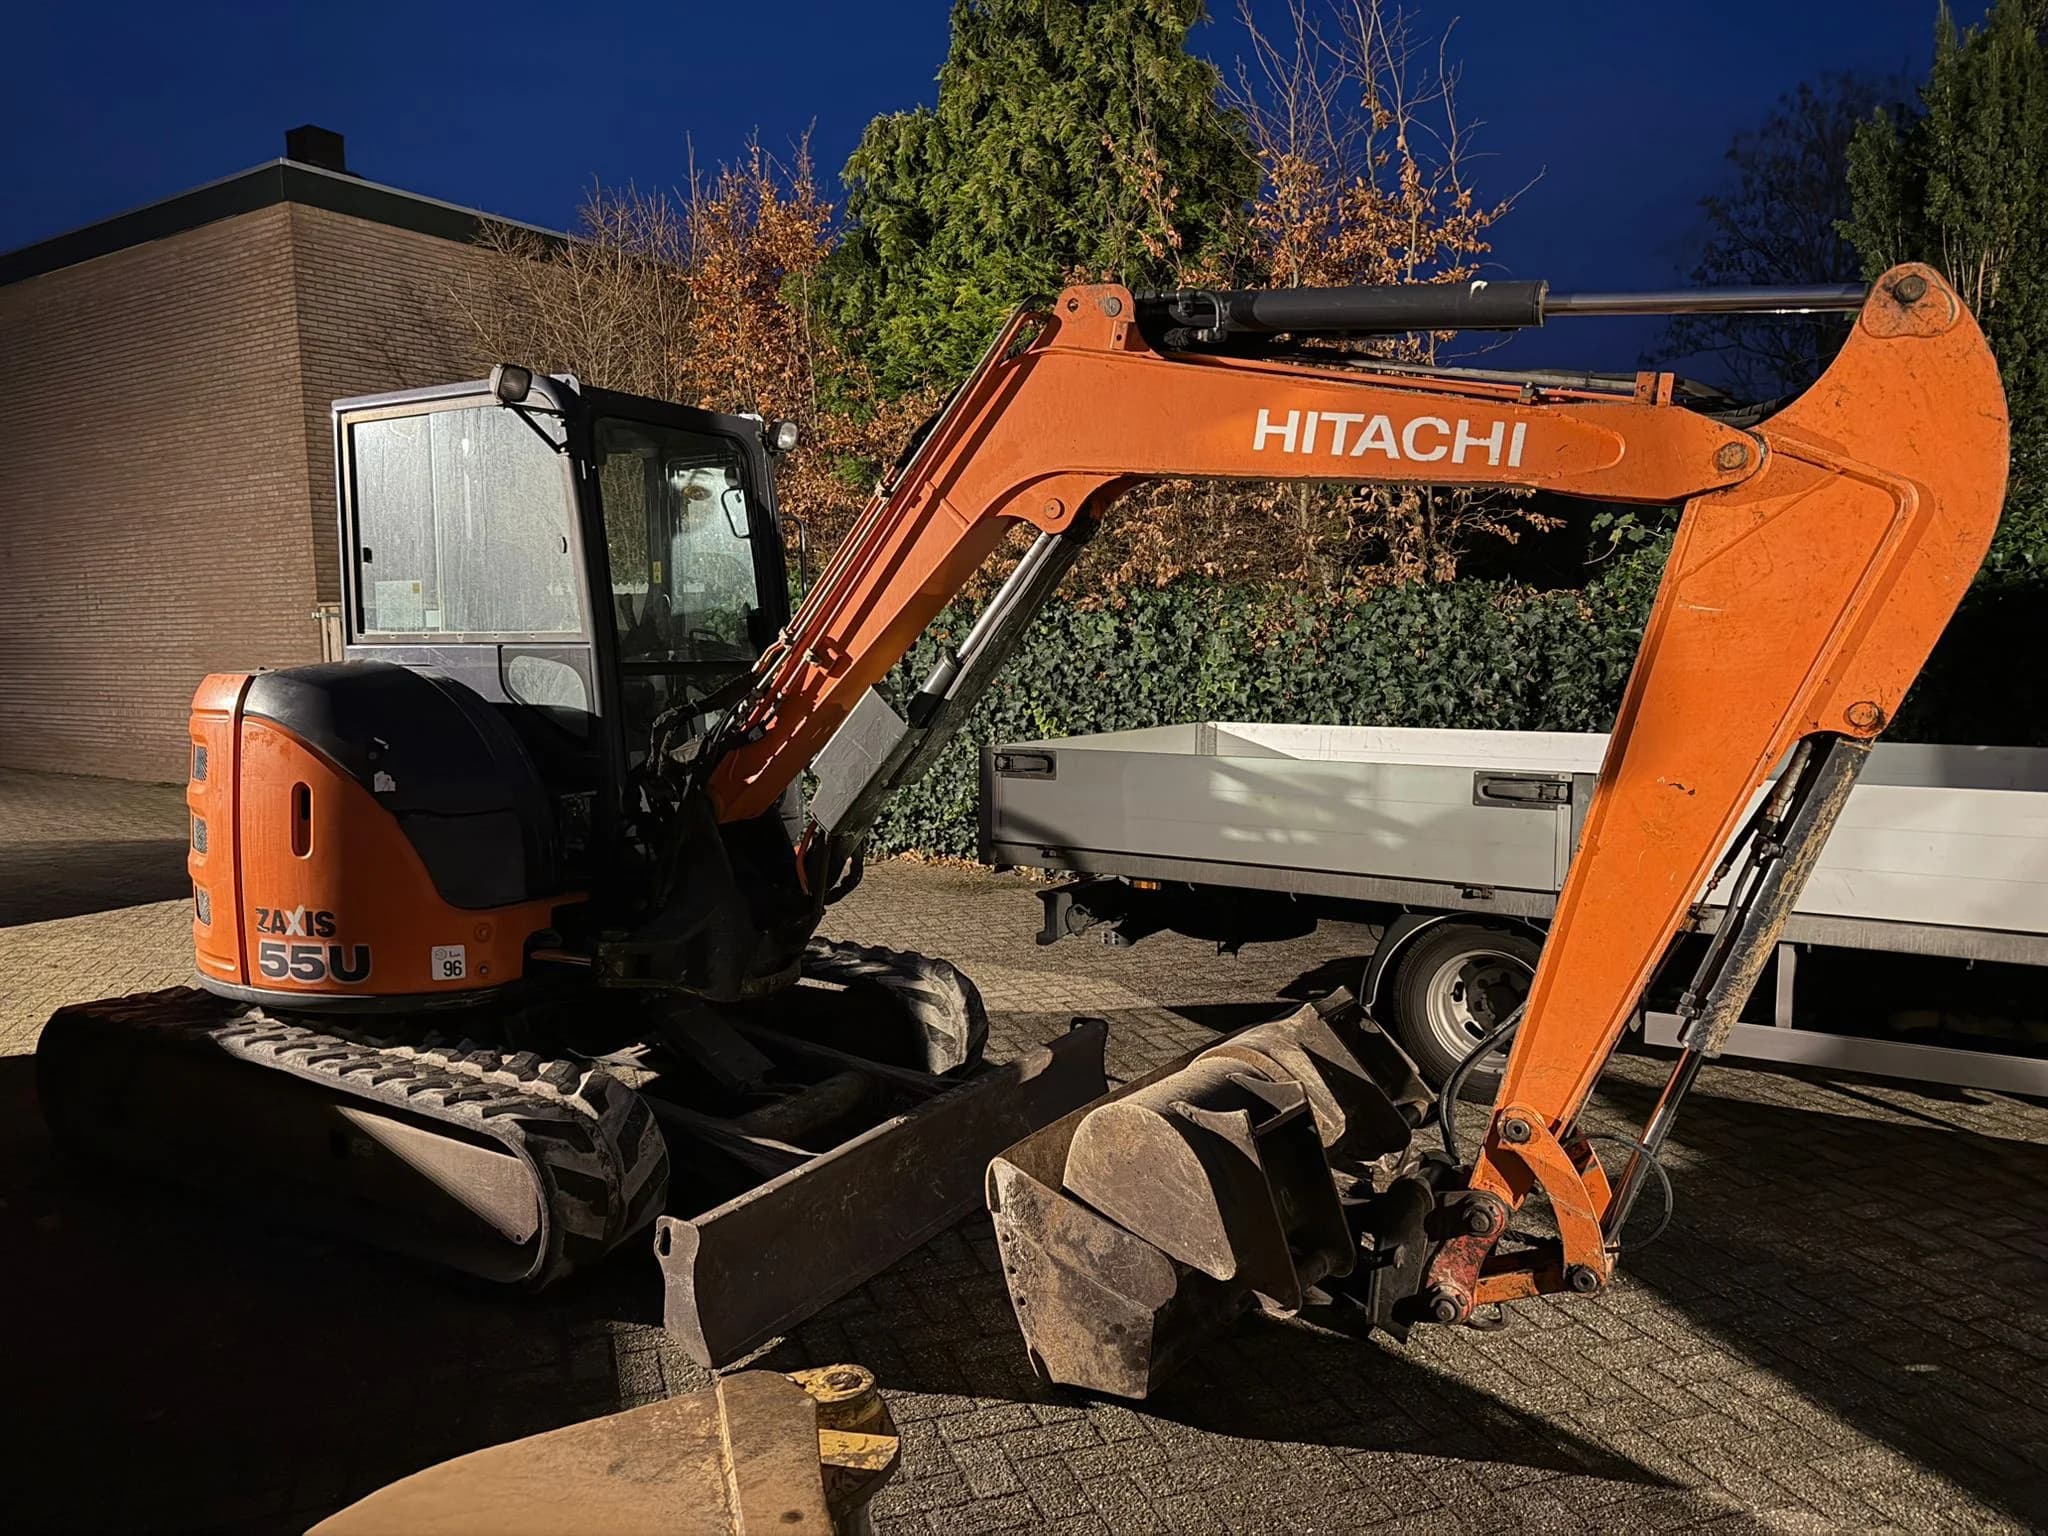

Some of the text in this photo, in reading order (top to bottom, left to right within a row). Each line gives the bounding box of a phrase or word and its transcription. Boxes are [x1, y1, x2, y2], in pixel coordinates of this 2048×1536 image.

[1253, 408, 1527, 467] HITACHI
[256, 905, 336, 938] ZAXIS
[260, 941, 371, 983] 55U
[443, 960, 463, 977] 96
